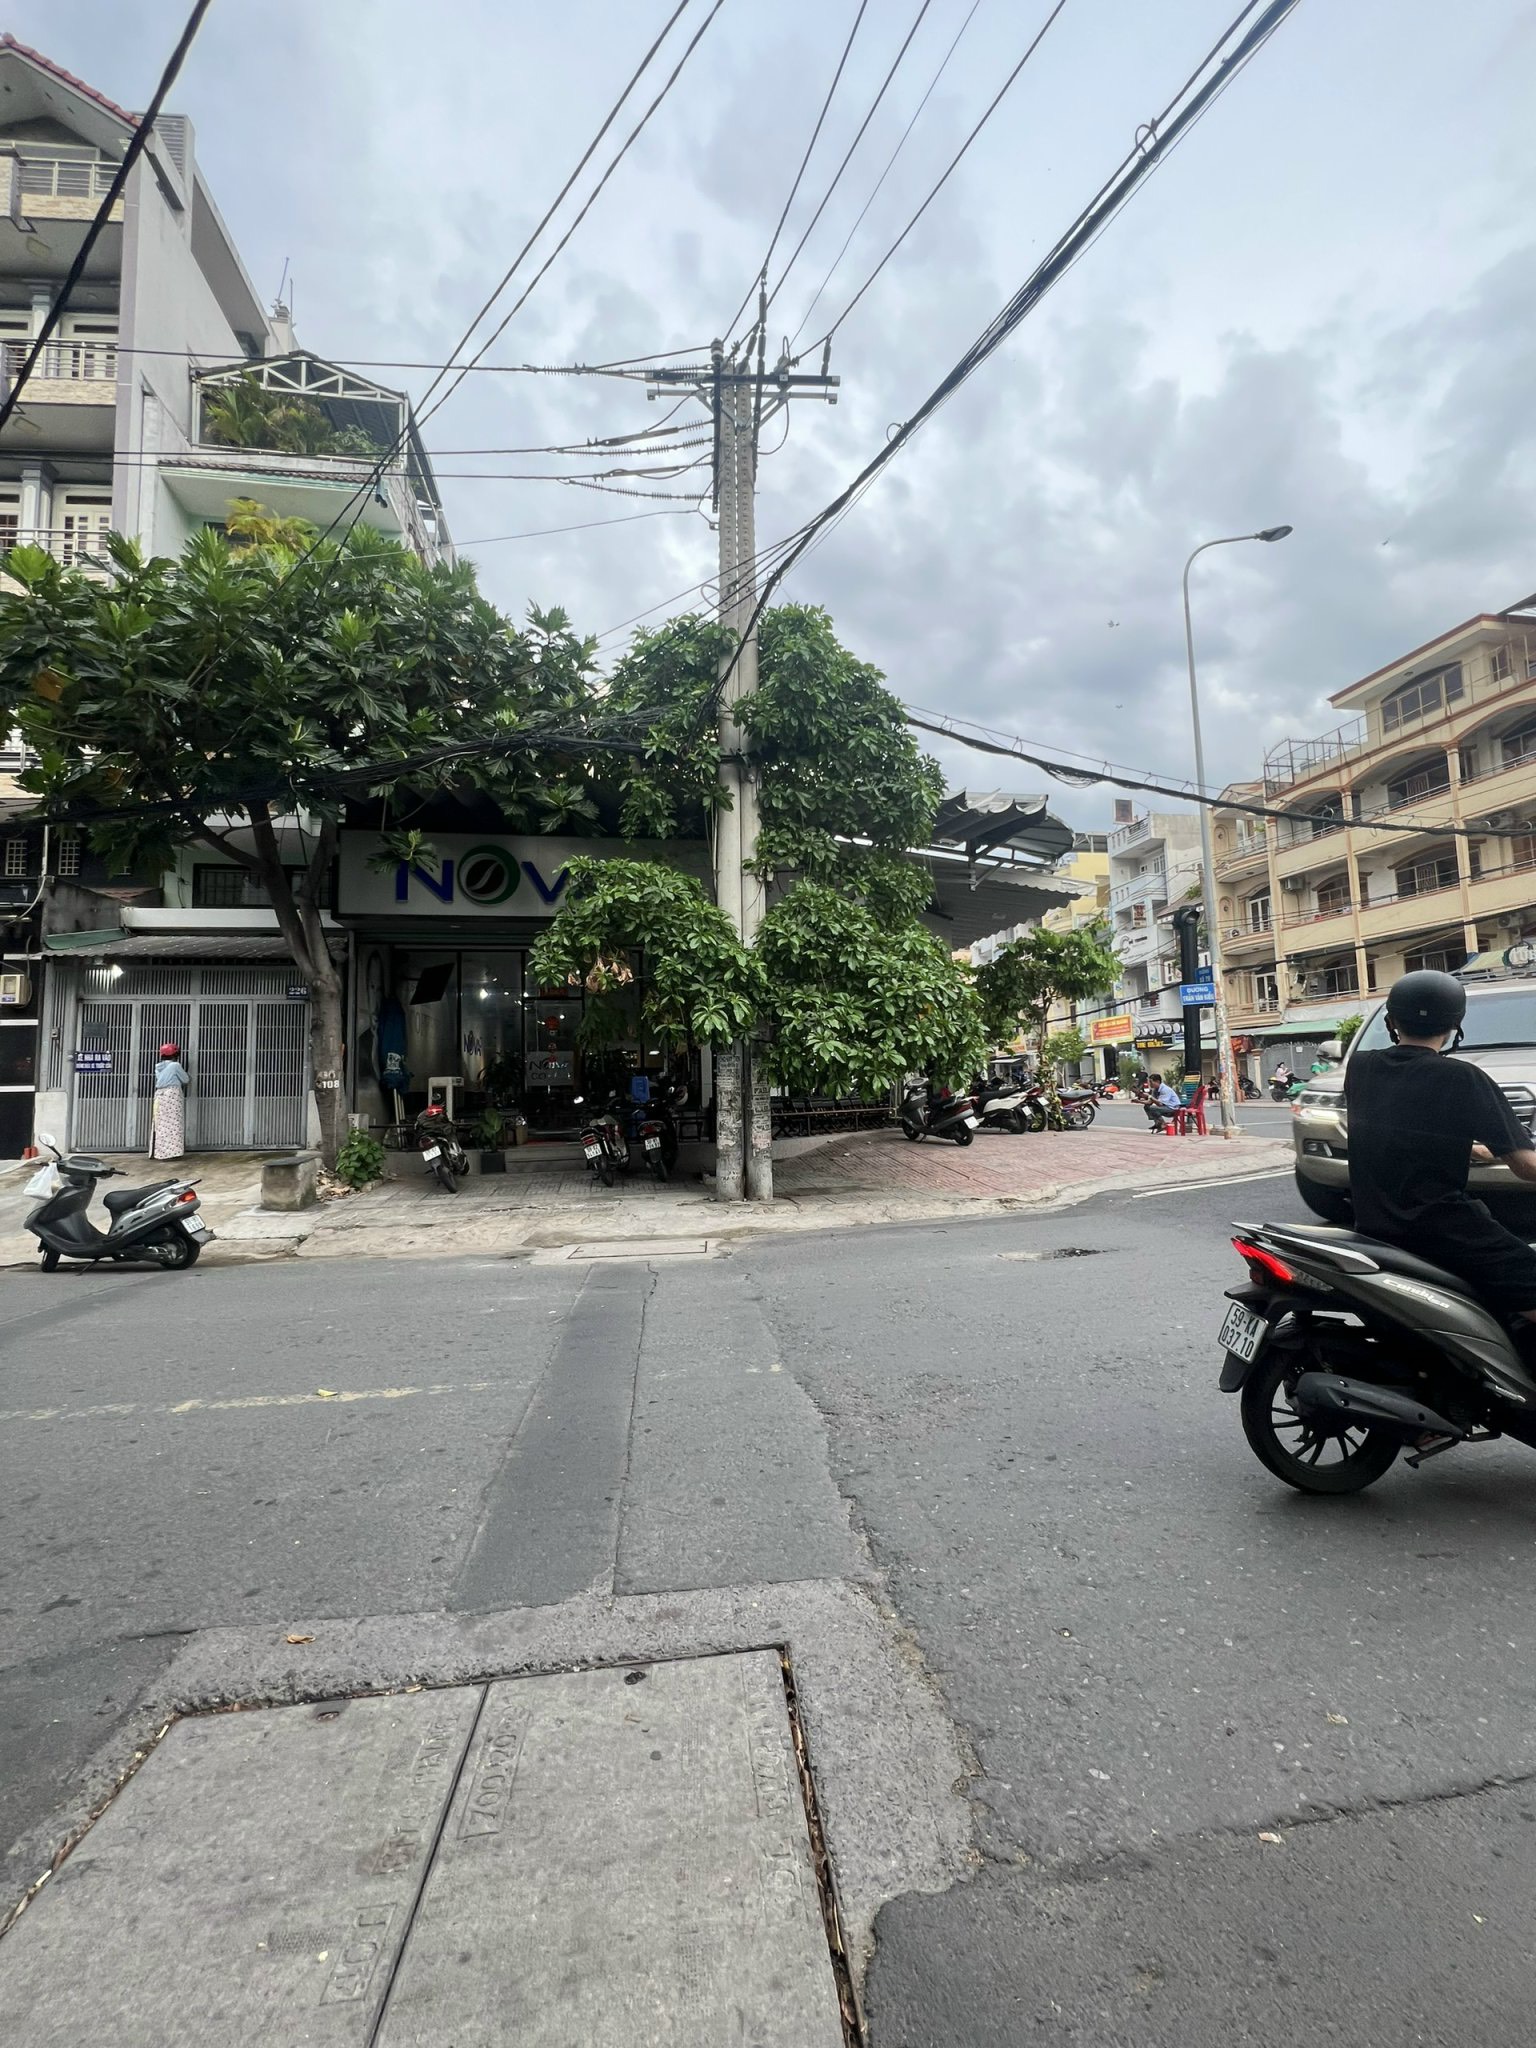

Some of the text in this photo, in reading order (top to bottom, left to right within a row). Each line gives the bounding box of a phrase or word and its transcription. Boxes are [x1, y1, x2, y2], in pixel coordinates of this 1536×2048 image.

[289, 987, 307, 995] 226
[322, 1080, 339, 1089] 108
[1230, 1308, 1259, 1337] 59-KA
[1222, 1325, 1254, 1358] 037.10
